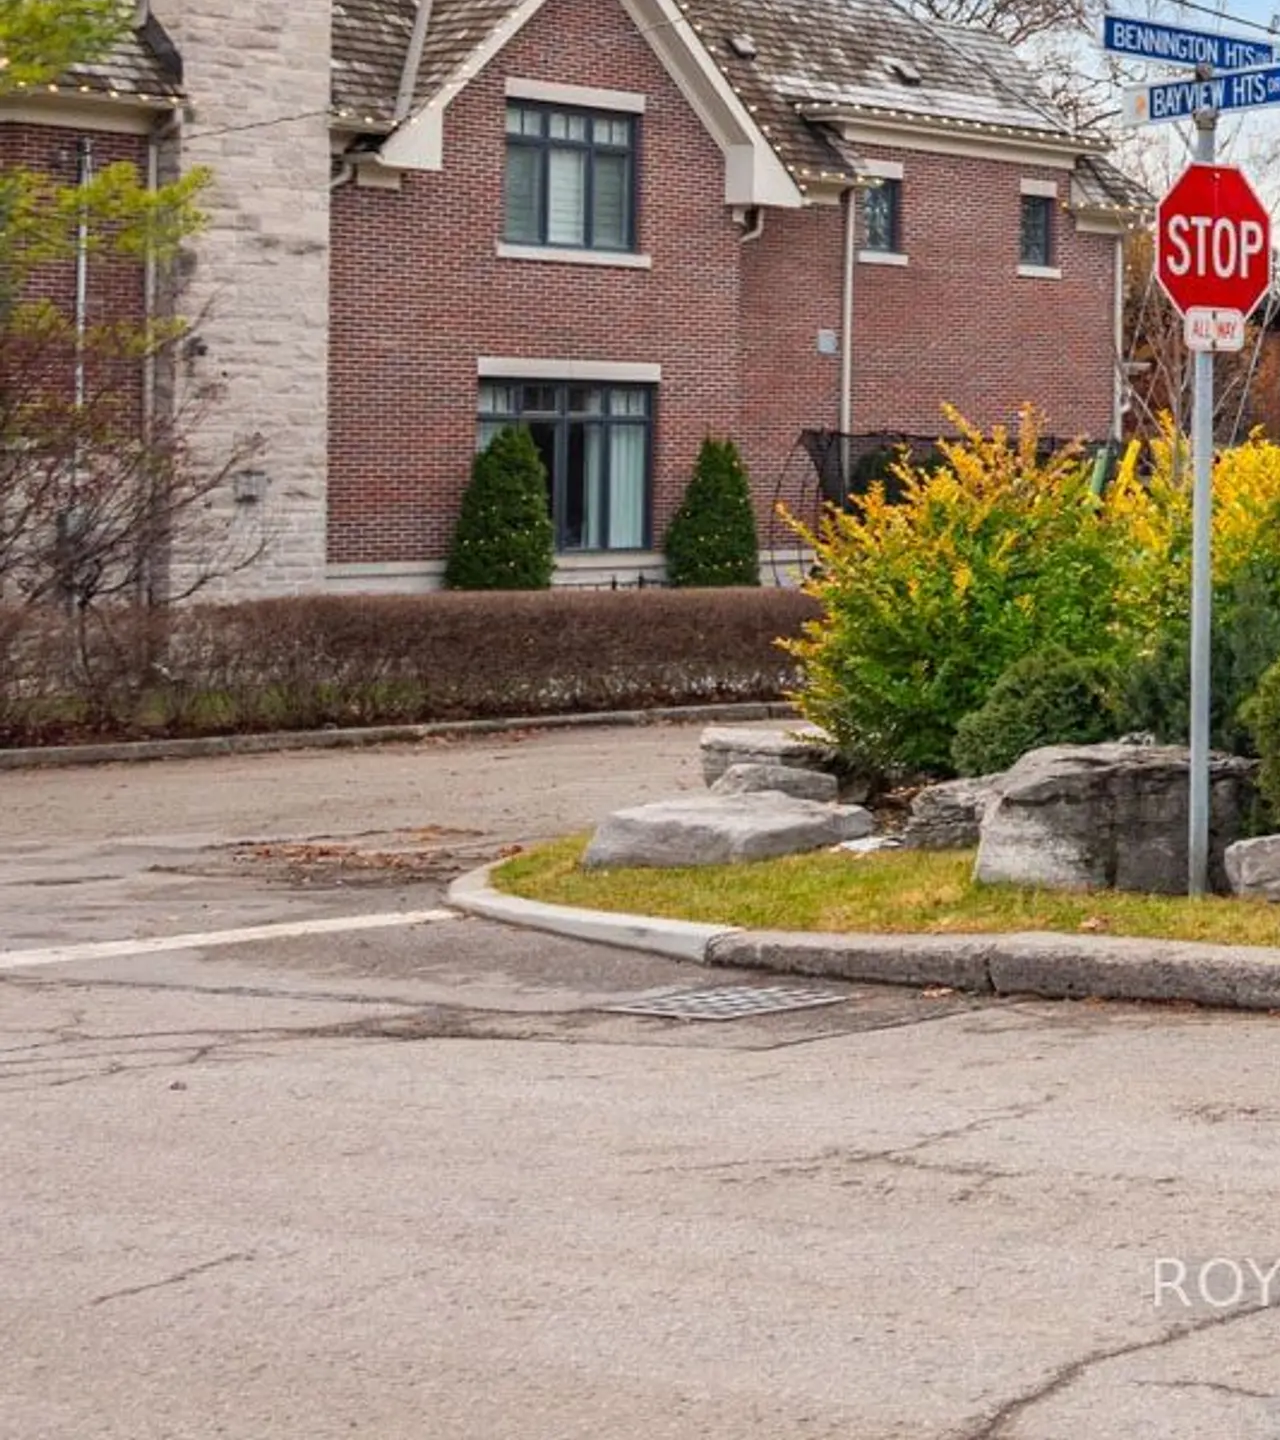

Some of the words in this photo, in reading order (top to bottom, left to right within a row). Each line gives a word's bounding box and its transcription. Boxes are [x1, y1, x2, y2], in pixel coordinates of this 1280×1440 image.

[1112, 21, 1219, 64] BENNINGTON
[1225, 42, 1257, 68] HTS
[1153, 79, 1226, 117] BAYVIEW
[1233, 74, 1267, 105] HTS
[1166, 214, 1264, 279] STOP
